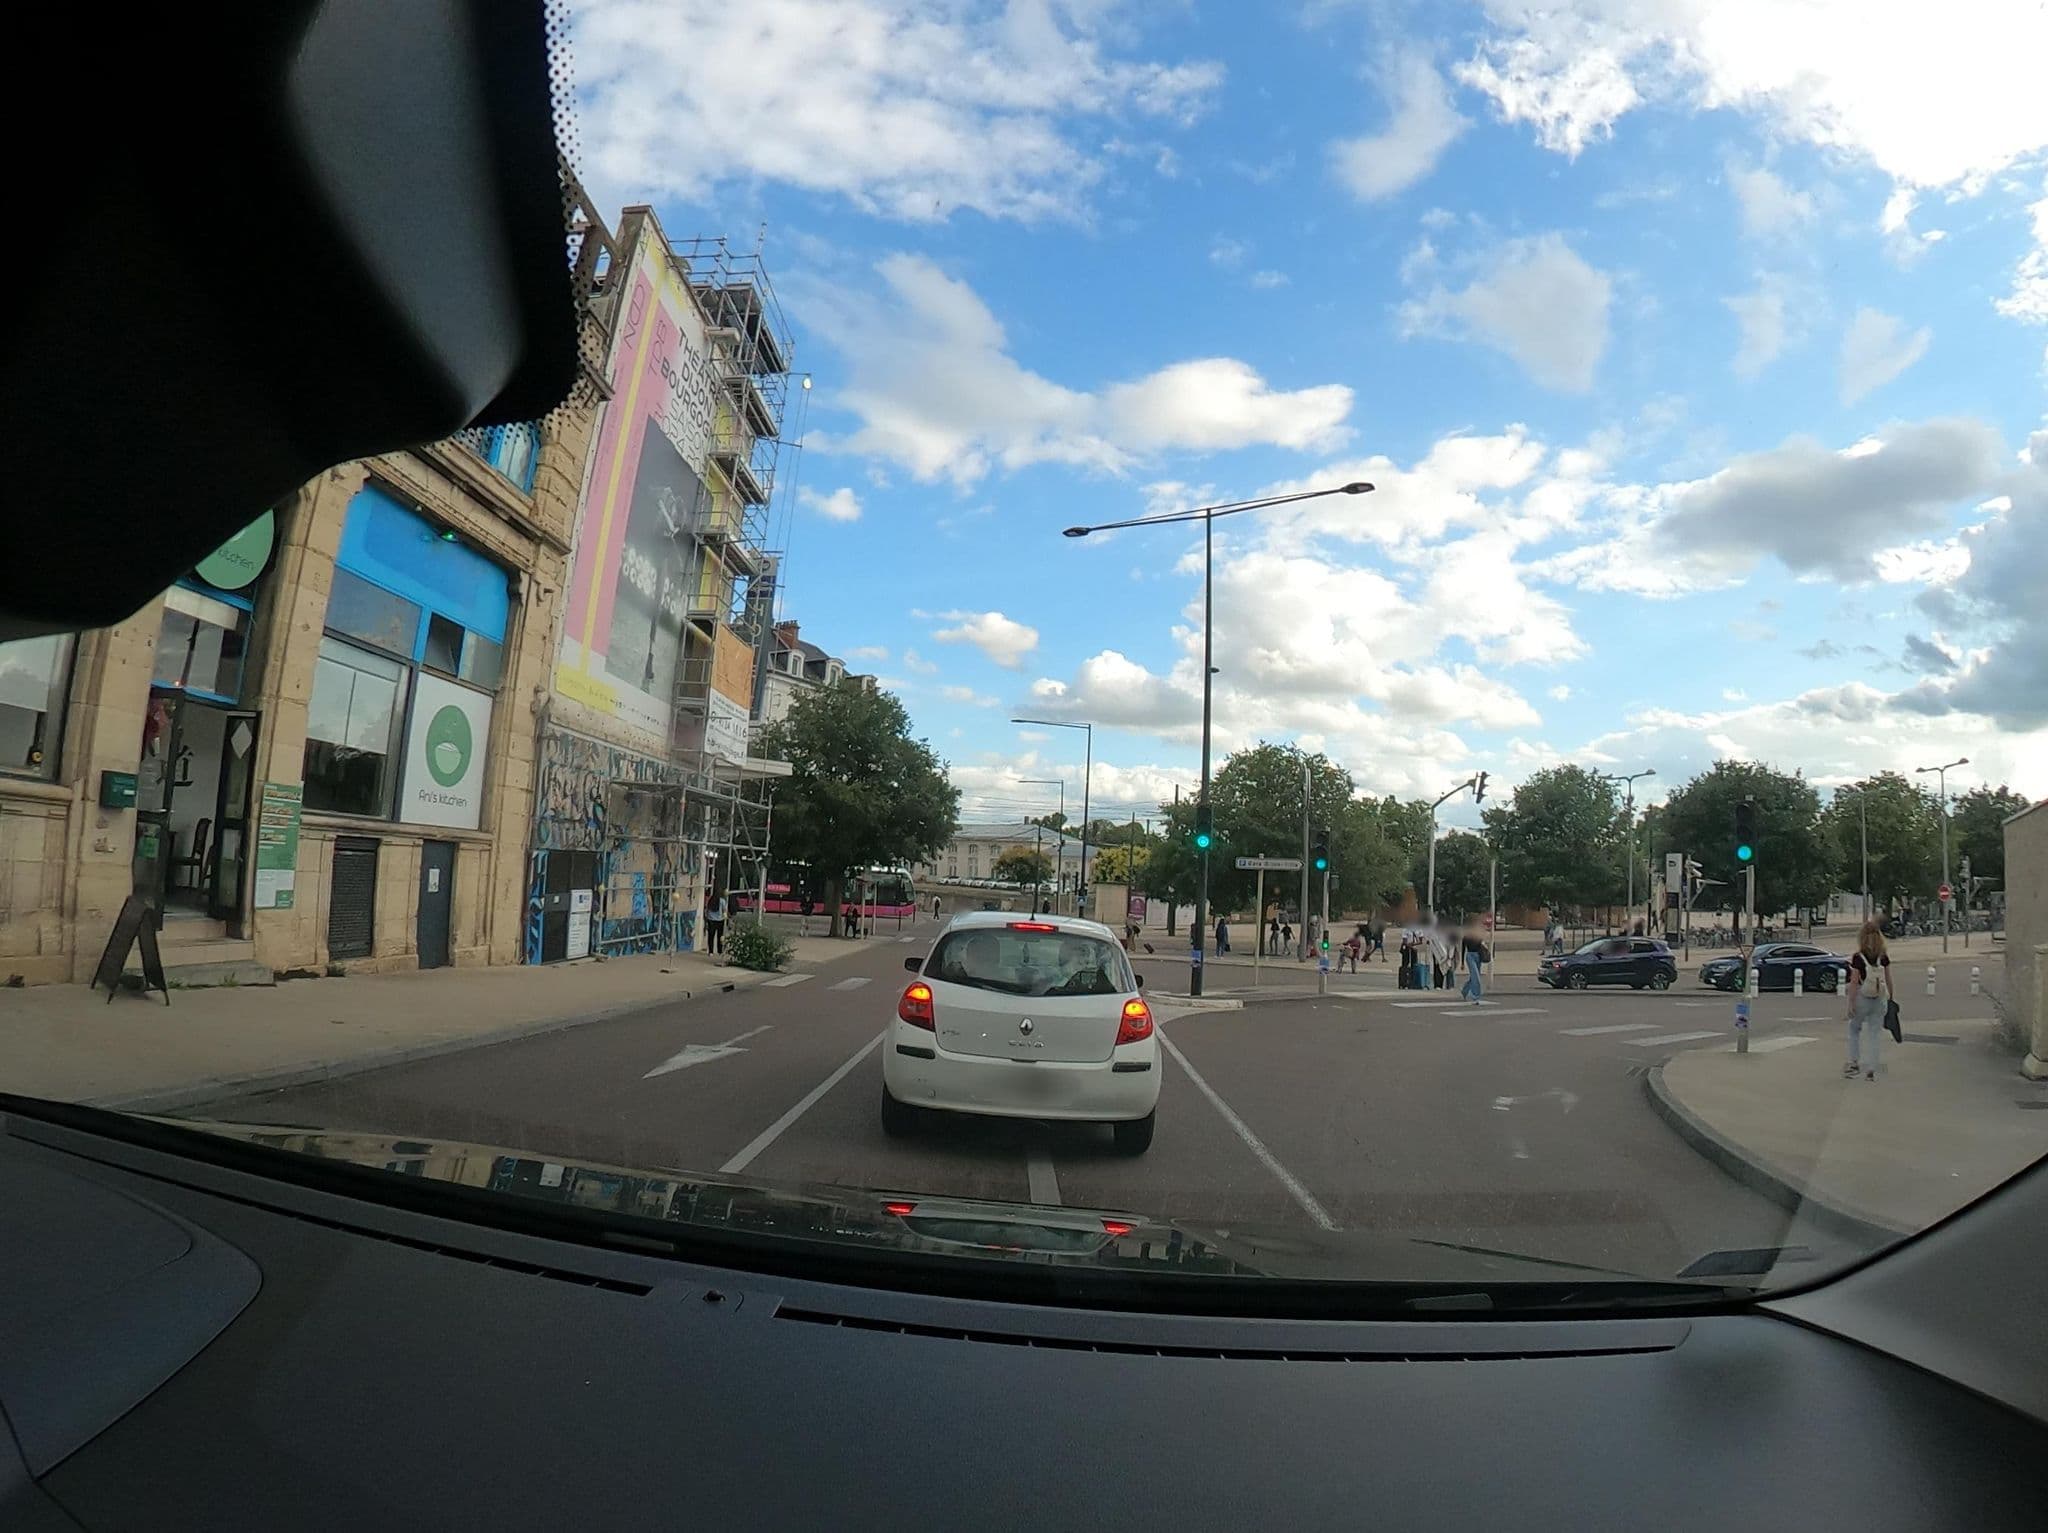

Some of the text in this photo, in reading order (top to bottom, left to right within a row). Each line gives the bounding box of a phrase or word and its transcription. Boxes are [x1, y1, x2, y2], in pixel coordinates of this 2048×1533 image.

[661, 356, 710, 439] BOURGOG
[682, 362, 712, 417] DIJON
[439, 793, 467, 807] kitchen
